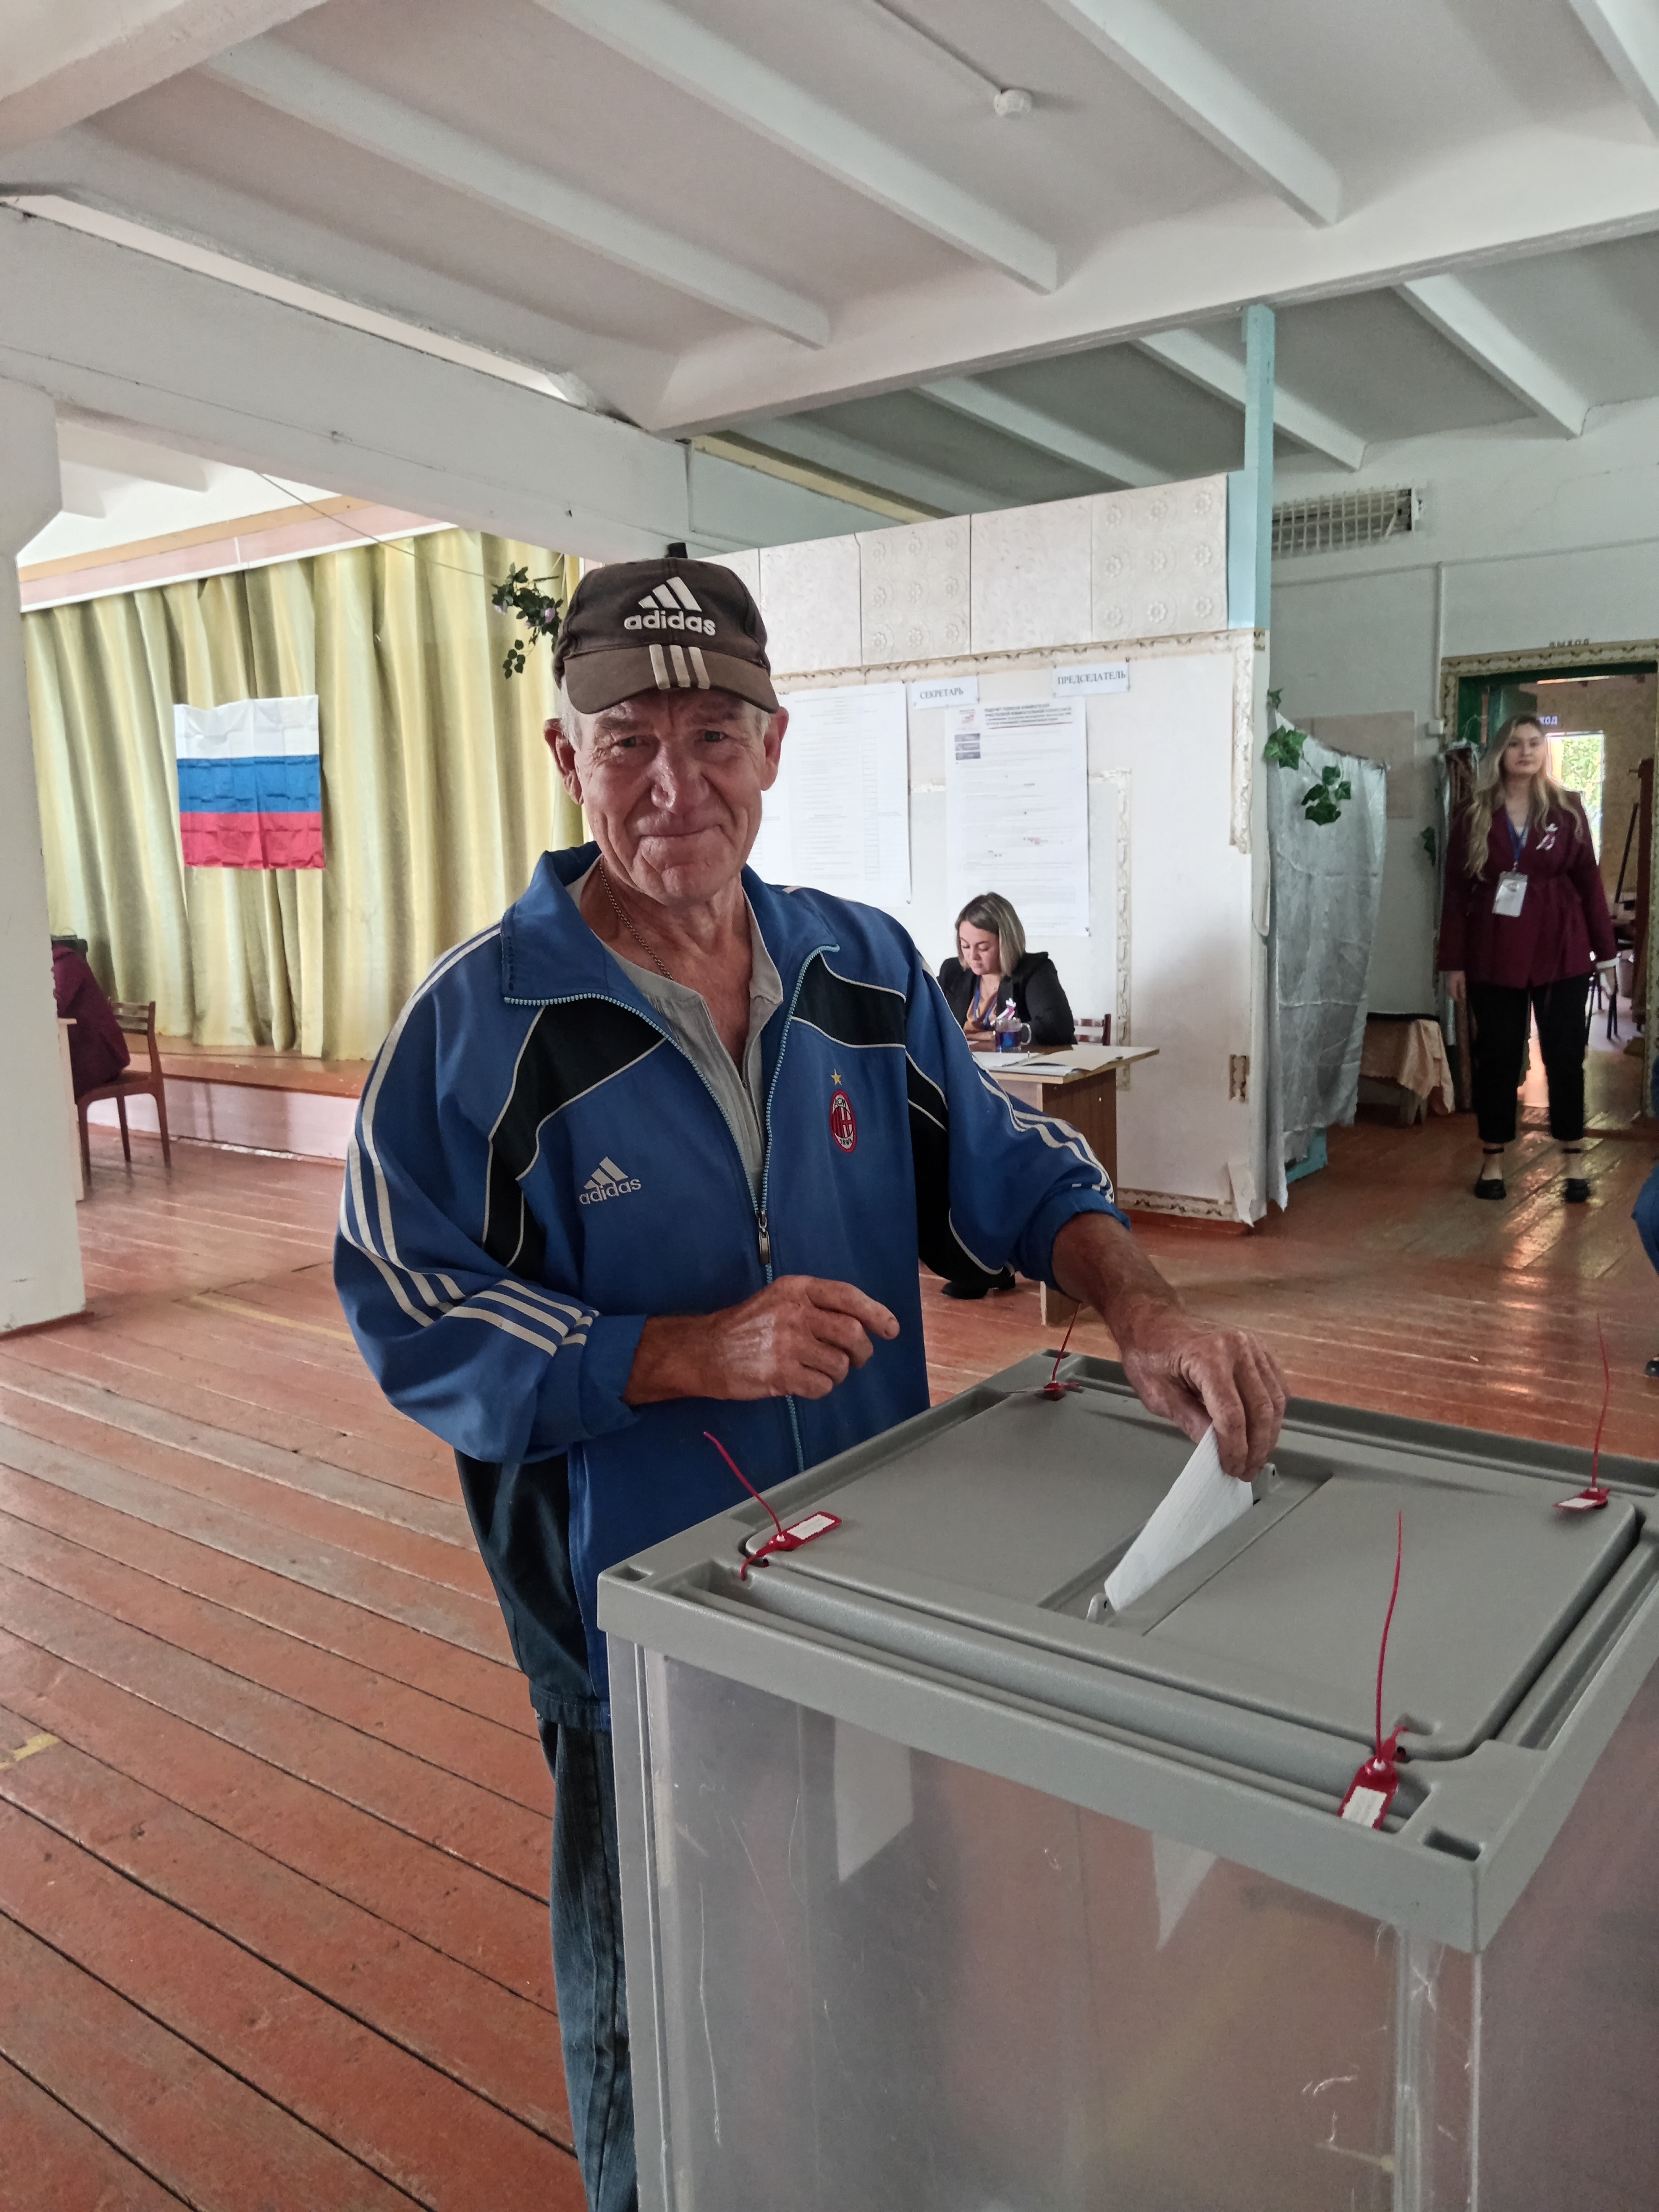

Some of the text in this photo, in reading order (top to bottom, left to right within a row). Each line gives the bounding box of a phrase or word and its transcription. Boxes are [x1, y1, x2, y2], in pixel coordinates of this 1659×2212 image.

[624, 610, 716, 636] adidas
[1058, 671, 1126, 684] ПРЕДСЕДАТЕЛЬ
[920, 687, 964, 699] СЕКРЕТАРЬ
[1539, 716, 1558, 725] ХОД
[834, 1098, 846, 1108] ACM
[579, 1179, 642, 1205] adidas
